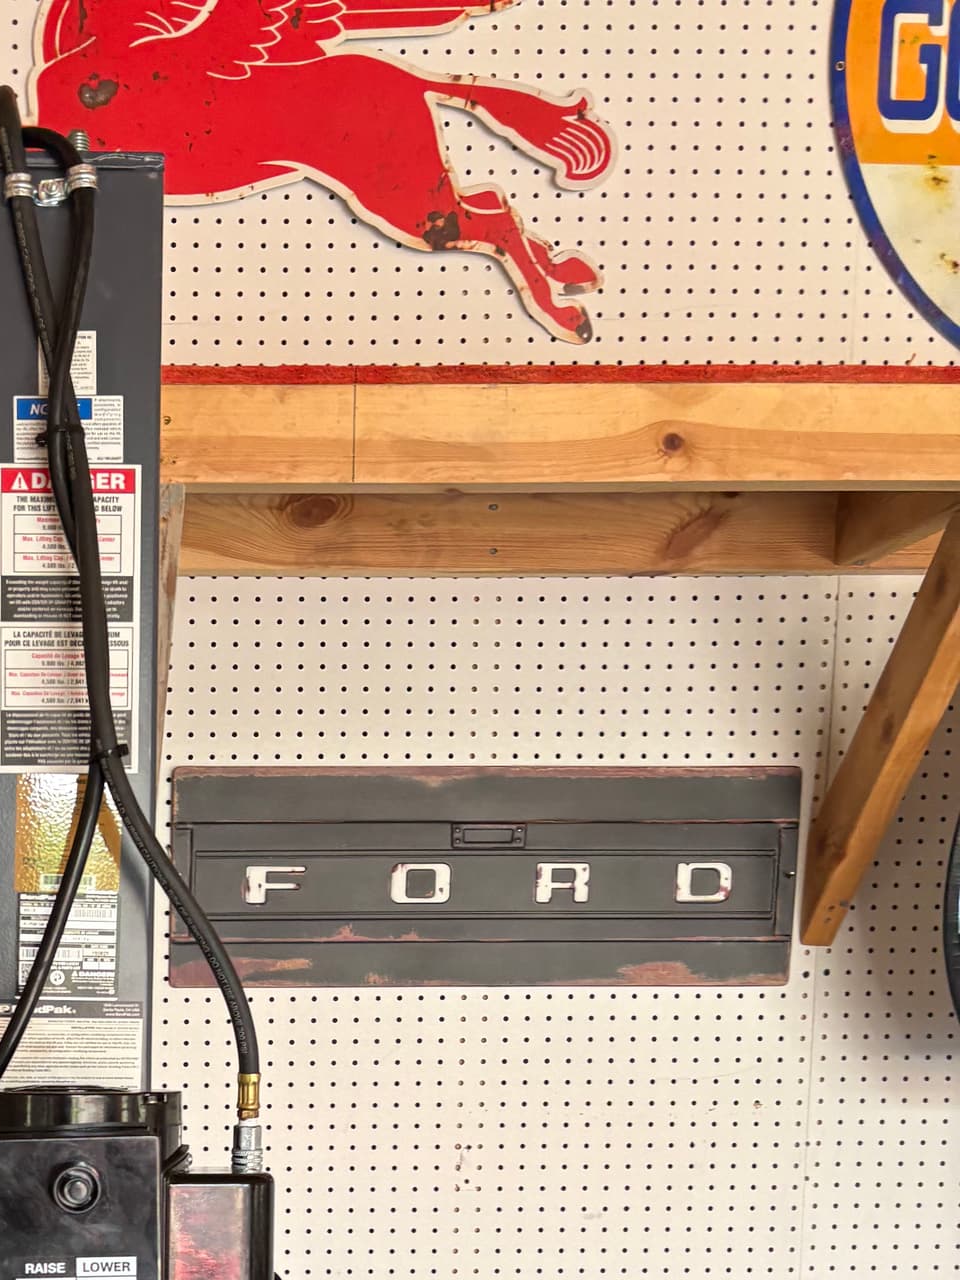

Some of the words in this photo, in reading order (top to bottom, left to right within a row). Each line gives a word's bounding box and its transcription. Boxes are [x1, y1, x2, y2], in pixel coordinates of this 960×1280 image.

[877, 0, 960, 133] G
[244, 862, 732, 906] FORD
[25, 1263, 66, 1274] RAISE
[83, 1262, 130, 1272] LOWER
